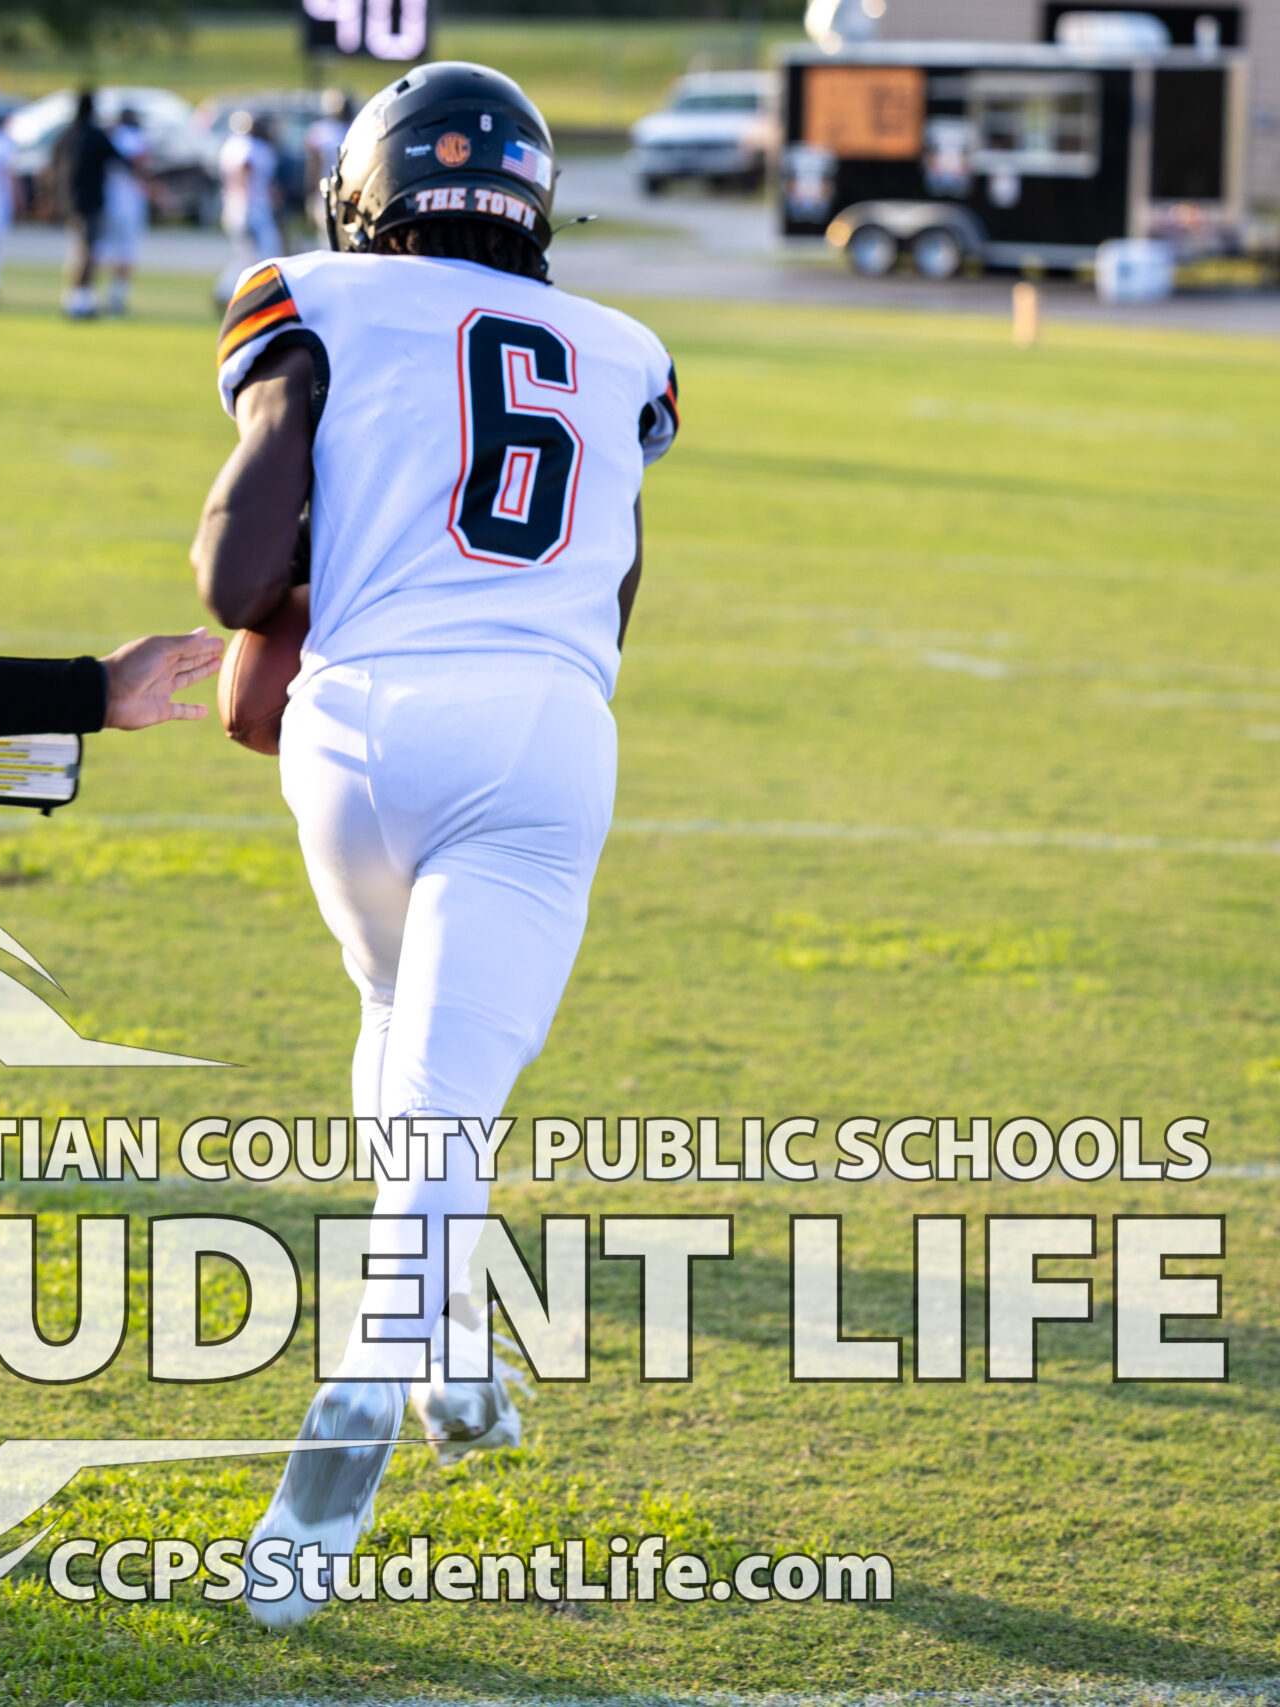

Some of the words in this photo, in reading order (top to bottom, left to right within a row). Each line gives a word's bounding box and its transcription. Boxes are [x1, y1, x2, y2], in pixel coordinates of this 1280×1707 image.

[415, 187, 467, 213] THE
[474, 188, 537, 232] TOWN
[447, 307, 583, 568] 6
